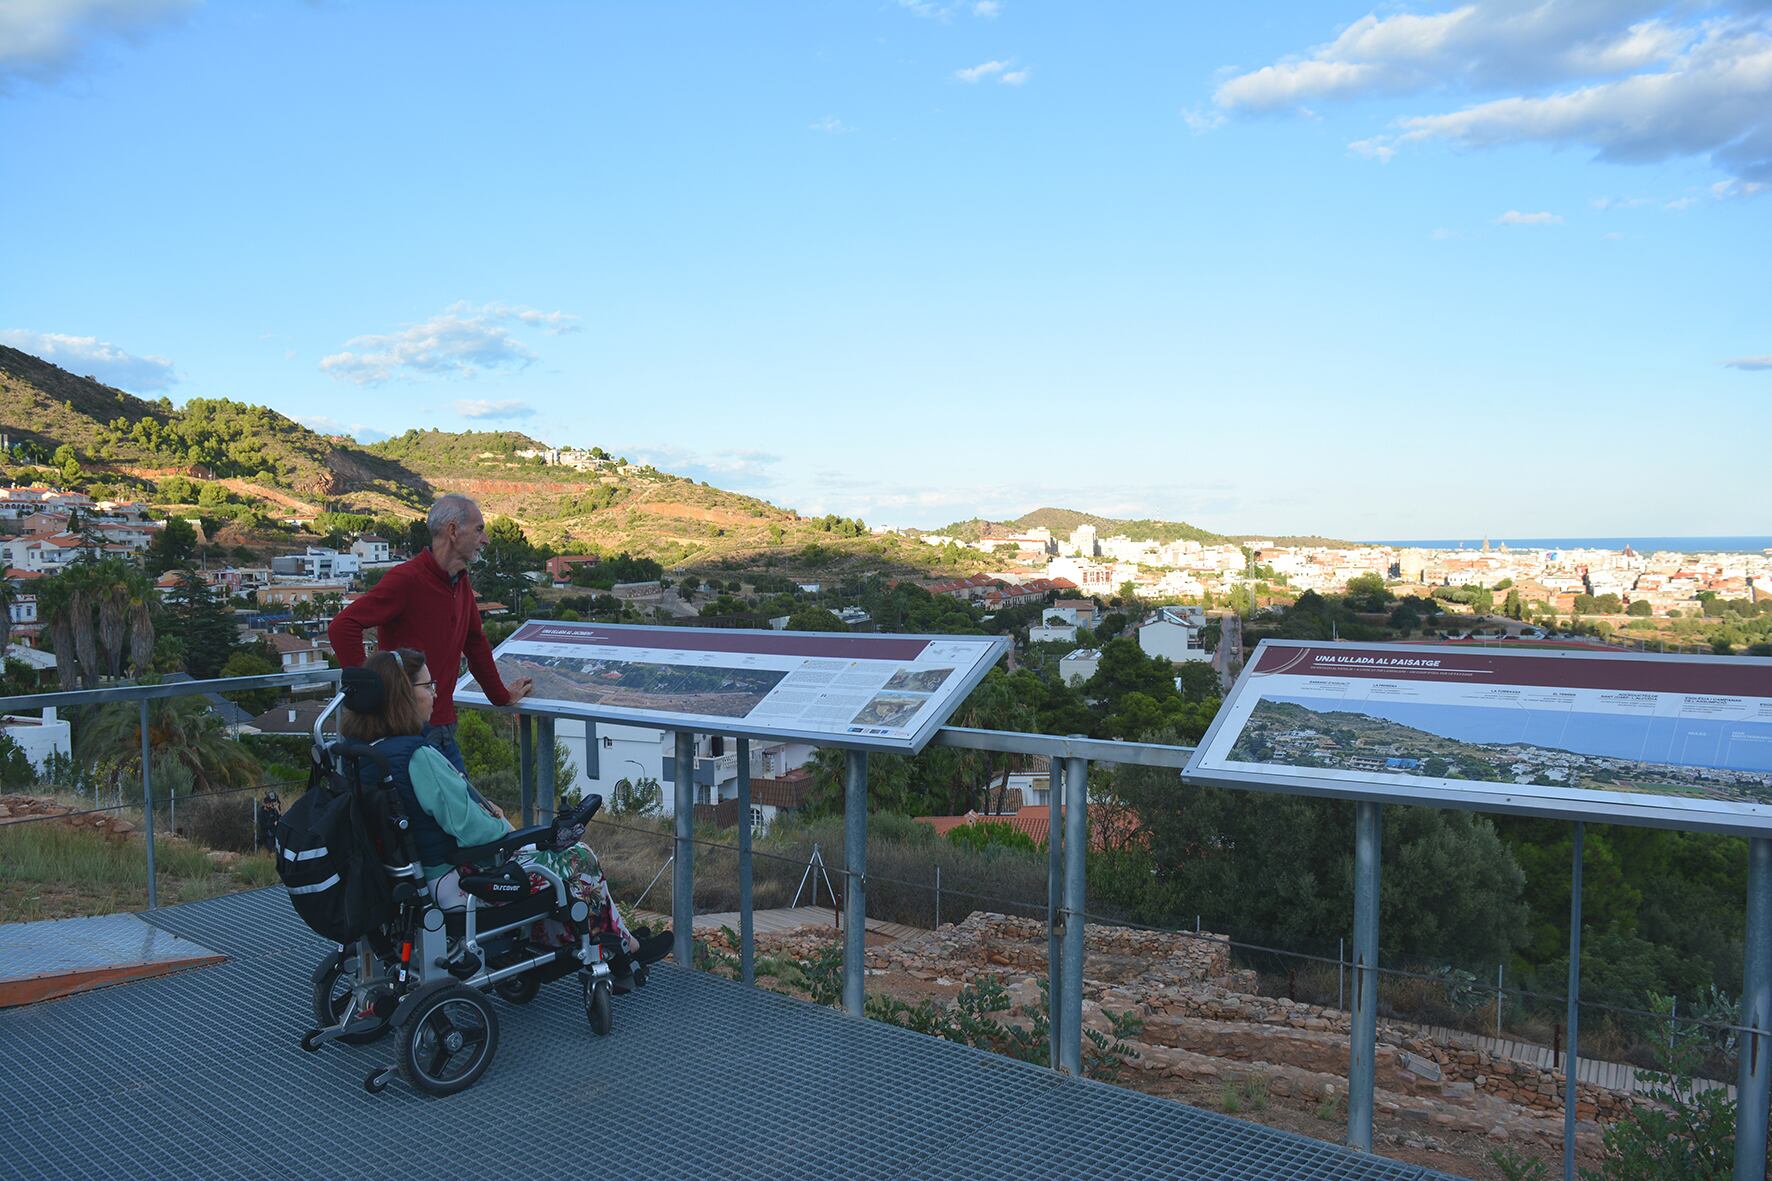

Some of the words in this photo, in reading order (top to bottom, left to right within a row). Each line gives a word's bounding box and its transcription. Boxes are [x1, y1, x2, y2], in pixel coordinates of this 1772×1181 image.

[1314, 655, 1336, 663] UNA
[1337, 656, 1374, 664] ULLADA
[1391, 658, 1441, 667] PAISATGE
